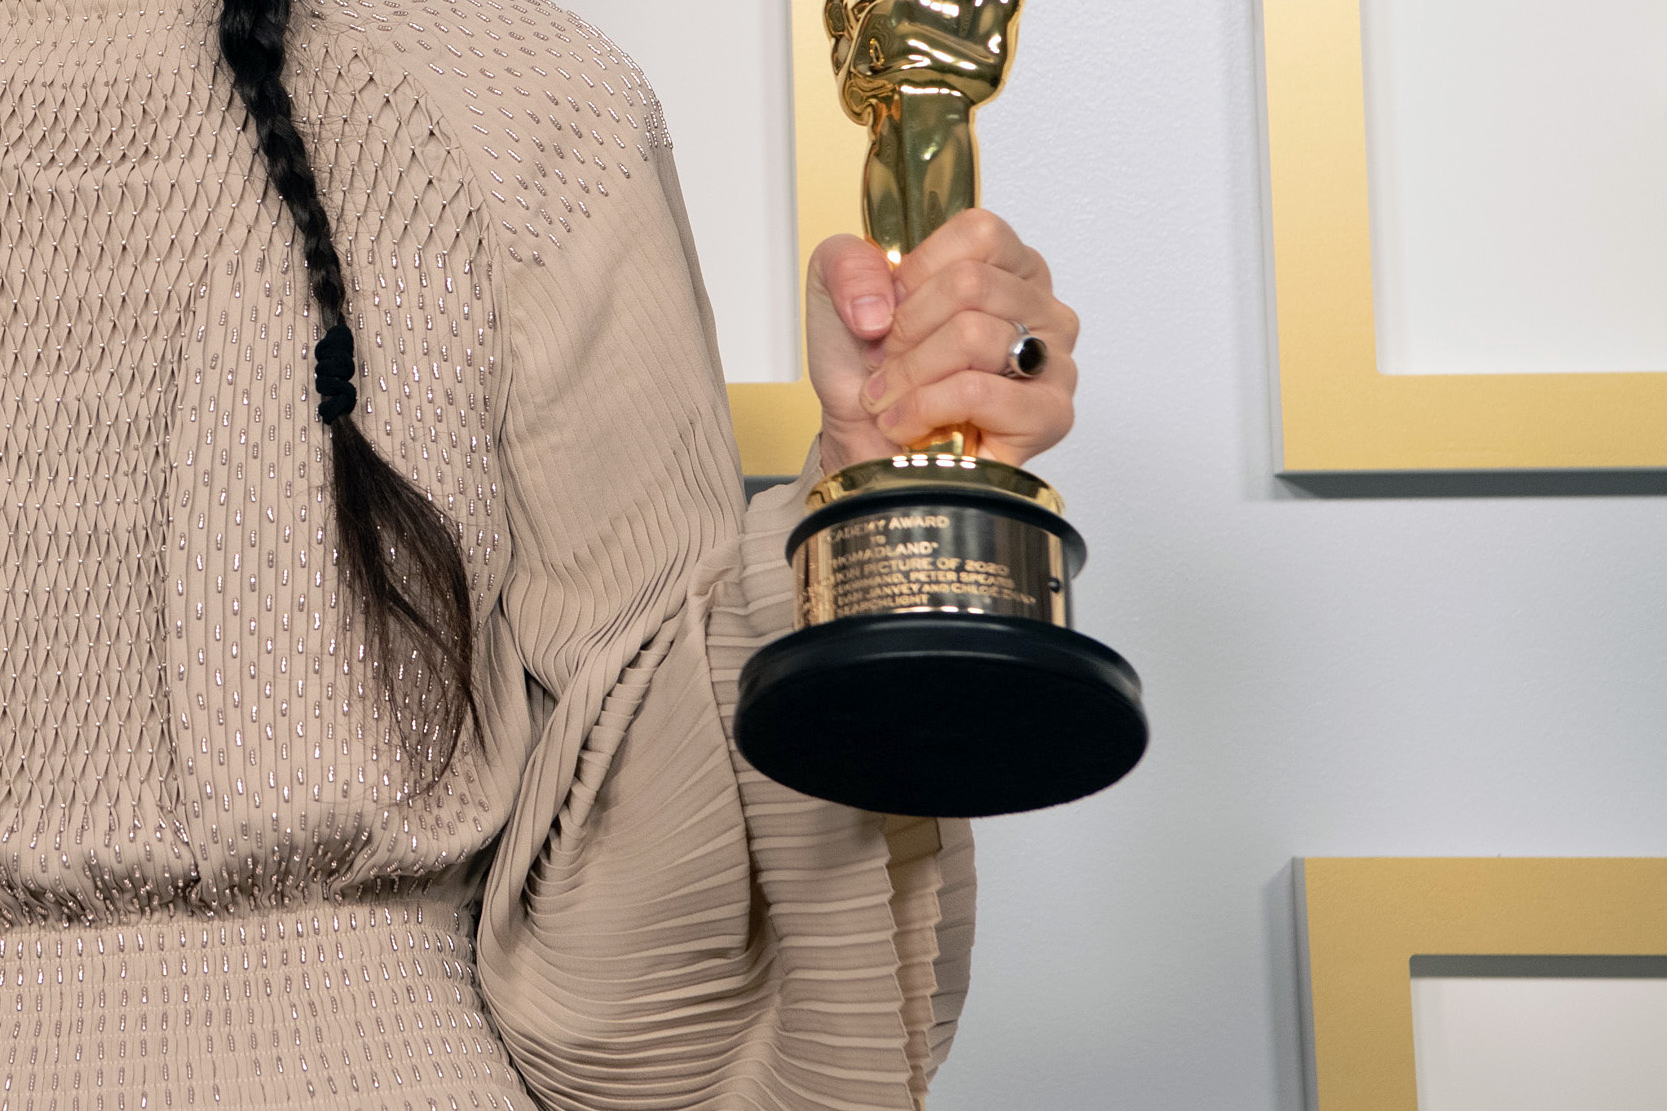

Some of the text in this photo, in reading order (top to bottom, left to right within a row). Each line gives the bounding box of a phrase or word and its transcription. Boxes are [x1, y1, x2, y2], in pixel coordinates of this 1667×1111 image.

[889, 515, 950, 530] AWARD
[863, 558, 934, 575] PICTURE
[936, 557, 962, 569] OF
[965, 559, 1010, 575] 2020
[909, 571, 958, 582] PETER
[921, 583, 950, 593] AND
